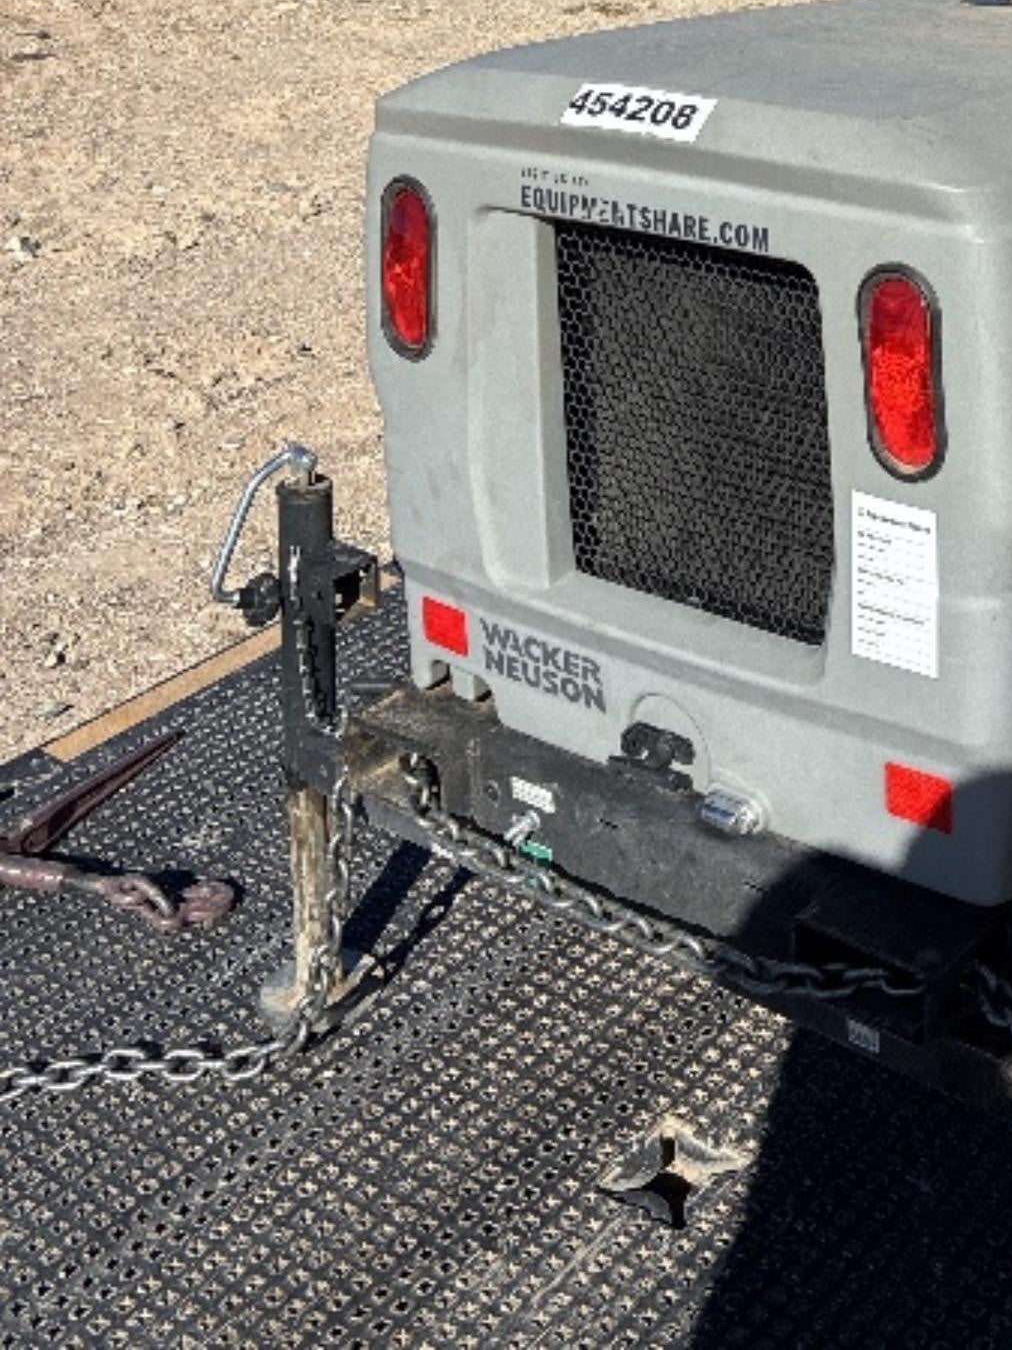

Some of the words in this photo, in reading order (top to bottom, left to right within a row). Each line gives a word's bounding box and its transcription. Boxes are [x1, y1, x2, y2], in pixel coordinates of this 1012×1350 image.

[568, 89, 699, 130] 454208
[521, 184, 770, 252] EQUIPMENTSHARE.COM
[479, 617, 601, 685] WACKER
[483, 645, 607, 715] NEUSON
